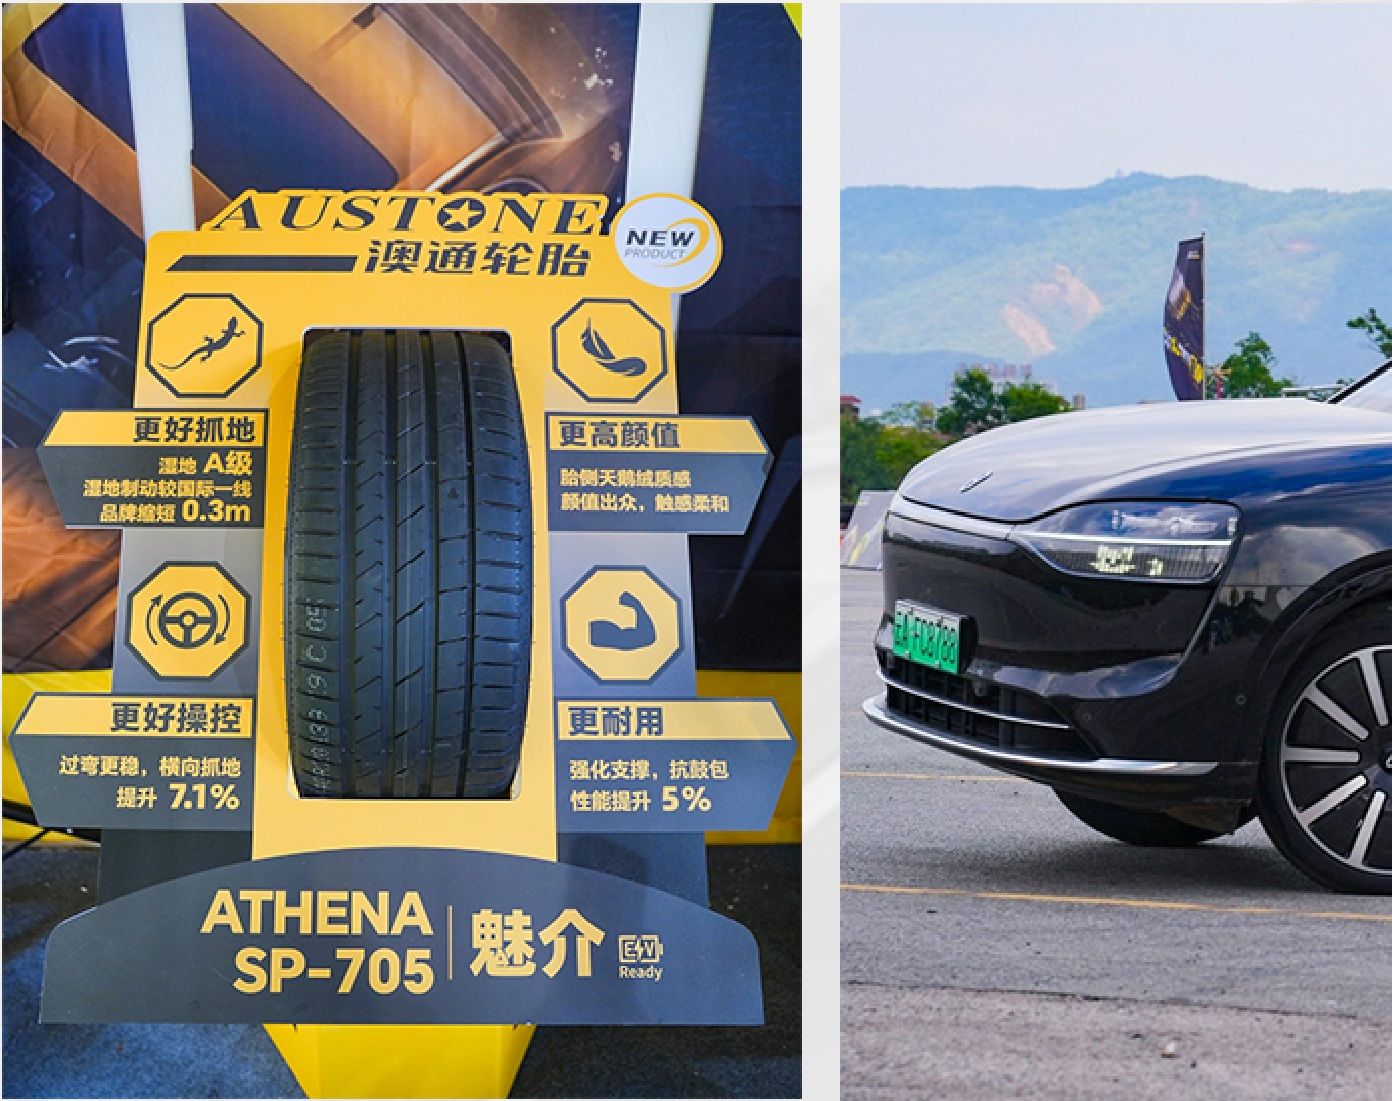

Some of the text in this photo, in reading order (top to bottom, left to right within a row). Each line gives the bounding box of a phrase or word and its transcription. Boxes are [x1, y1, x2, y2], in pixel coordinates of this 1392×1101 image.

[213, 195, 601, 235] AUSTONE
[626, 229, 696, 248] NEW
[364, 239, 592, 276] 澳通轮胎
[624, 249, 687, 260] PRODUCT
[133, 416, 256, 443] 更好抓地
[559, 420, 681, 448] 更高颜值
[159, 450, 253, 476] 湿地 A级
[82, 477, 253, 499] 湿地制动较国际一线
[559, 467, 692, 488] 胎侧天鹅绒质感
[100, 498, 251, 523] 品牌缩短 0.3m
[110, 702, 242, 733] 更好操控
[568, 706, 664, 736] 更耐用
[116, 783, 241, 810] 提升 7.1%
[569, 785, 713, 812] 性能提升 5%
[200, 889, 435, 935] ATHENA
[469, 908, 607, 978] 魅介
[233, 947, 436, 995] SP-705
[618, 965, 665, 982] Ready
